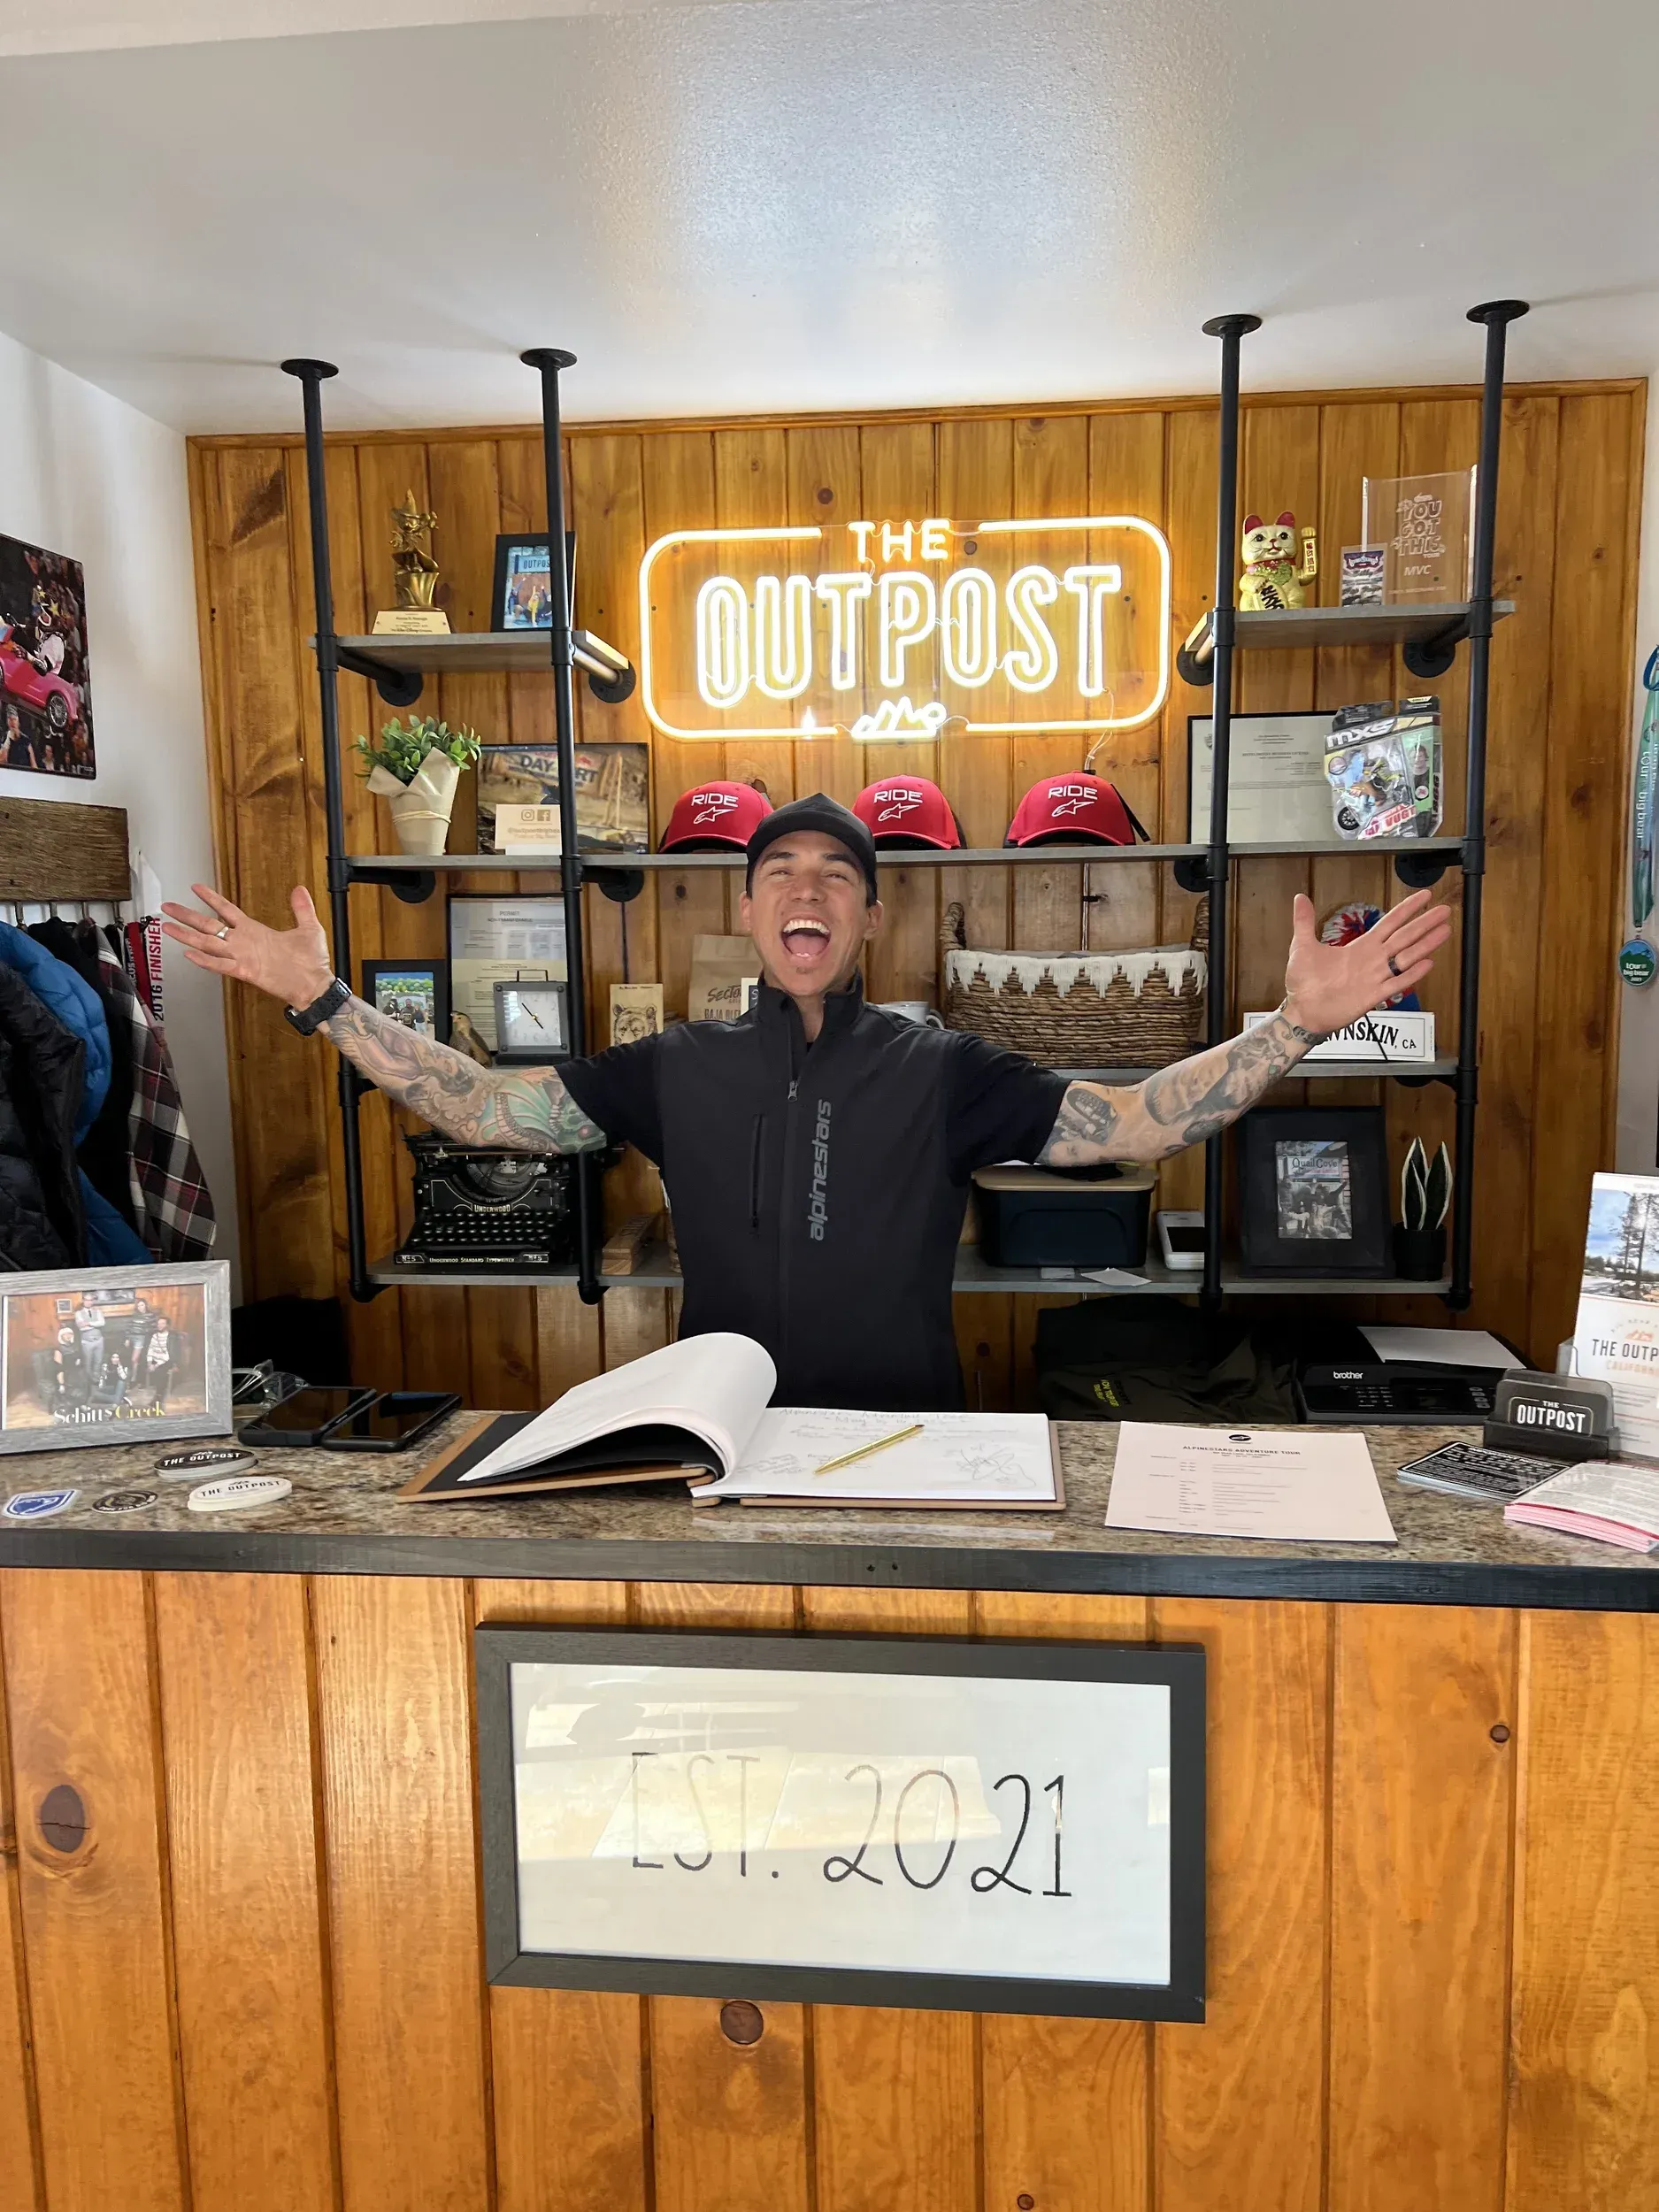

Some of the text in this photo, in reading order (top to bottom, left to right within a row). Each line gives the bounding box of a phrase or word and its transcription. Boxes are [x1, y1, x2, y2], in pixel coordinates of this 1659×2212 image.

[847, 518, 952, 563] THE
[1404, 565, 1432, 576] MVC
[695, 564, 1122, 709] OUTPOST
[519, 754, 556, 772] DAY
[575, 767, 599, 783] RT
[690, 793, 739, 808] RIDE
[872, 787, 924, 805] RIDE
[1048, 784, 1098, 801] RIDE
[147, 917, 165, 1022] 2016 FINISHER
[707, 984, 741, 1003] SECTO
[1326, 1021, 1417, 1049] WNSKIN, CA
[807, 1099, 832, 1241] alpinestars
[1592, 1338, 1659, 1363] THE OUTP
[1333, 1371, 1363, 1379] brother
[115, 1401, 166, 1420] Creek
[1542, 1400, 1560, 1409] THE
[1517, 1403, 1586, 1433] OUTPOST
[164, 1452, 242, 1467] THE OUTPOST
[200, 1479, 280, 1498] THE OUTPOST
[631, 1751, 1072, 1898] EST. 2021
